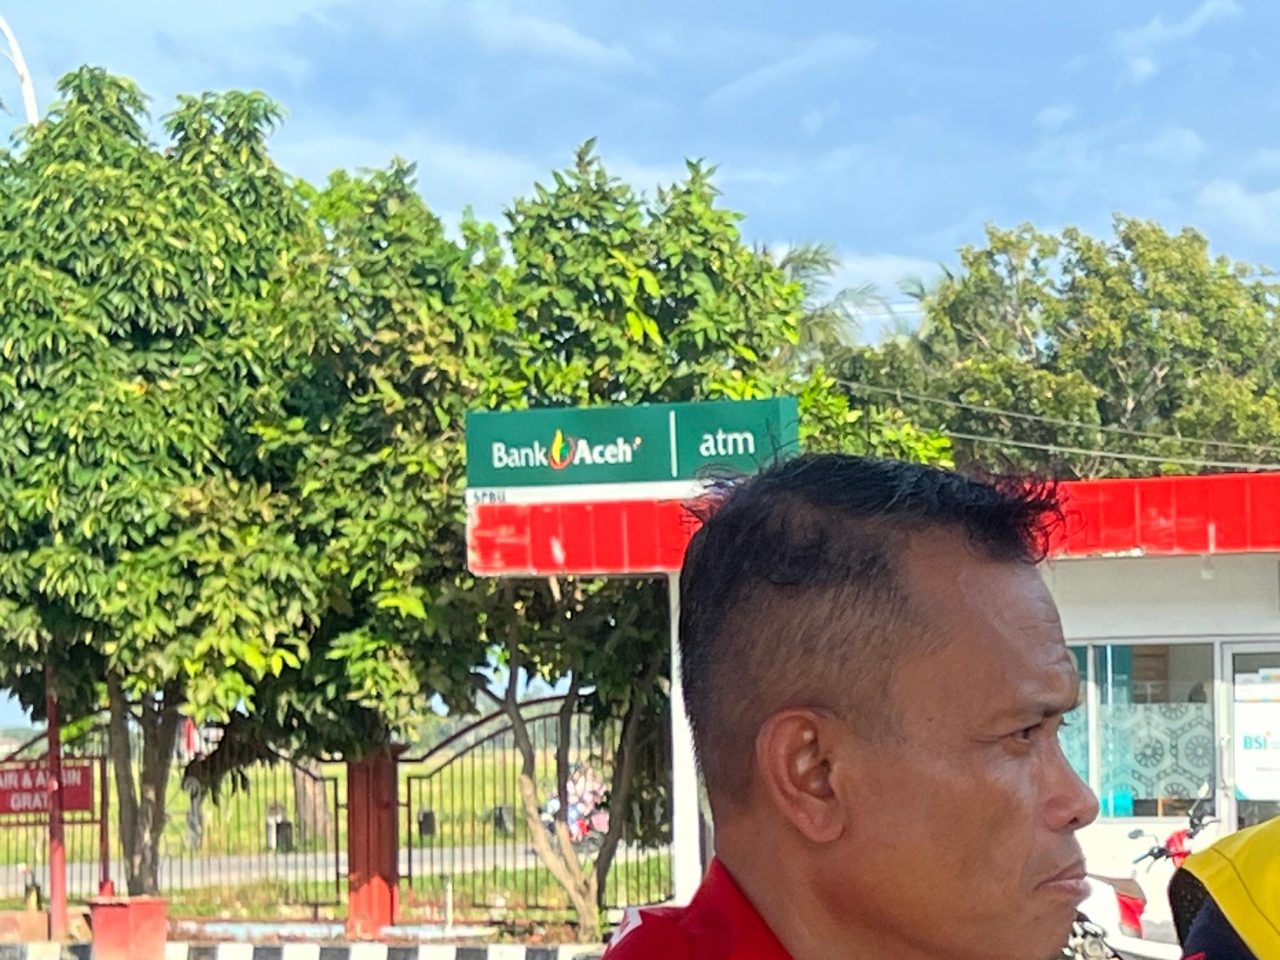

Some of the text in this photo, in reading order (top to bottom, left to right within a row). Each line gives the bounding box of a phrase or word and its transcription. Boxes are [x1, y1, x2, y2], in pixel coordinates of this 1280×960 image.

[492, 428, 755, 468] Bank Aceh atm
[1243, 735, 1267, 750] BSI
[21, 769, 33, 788] &
